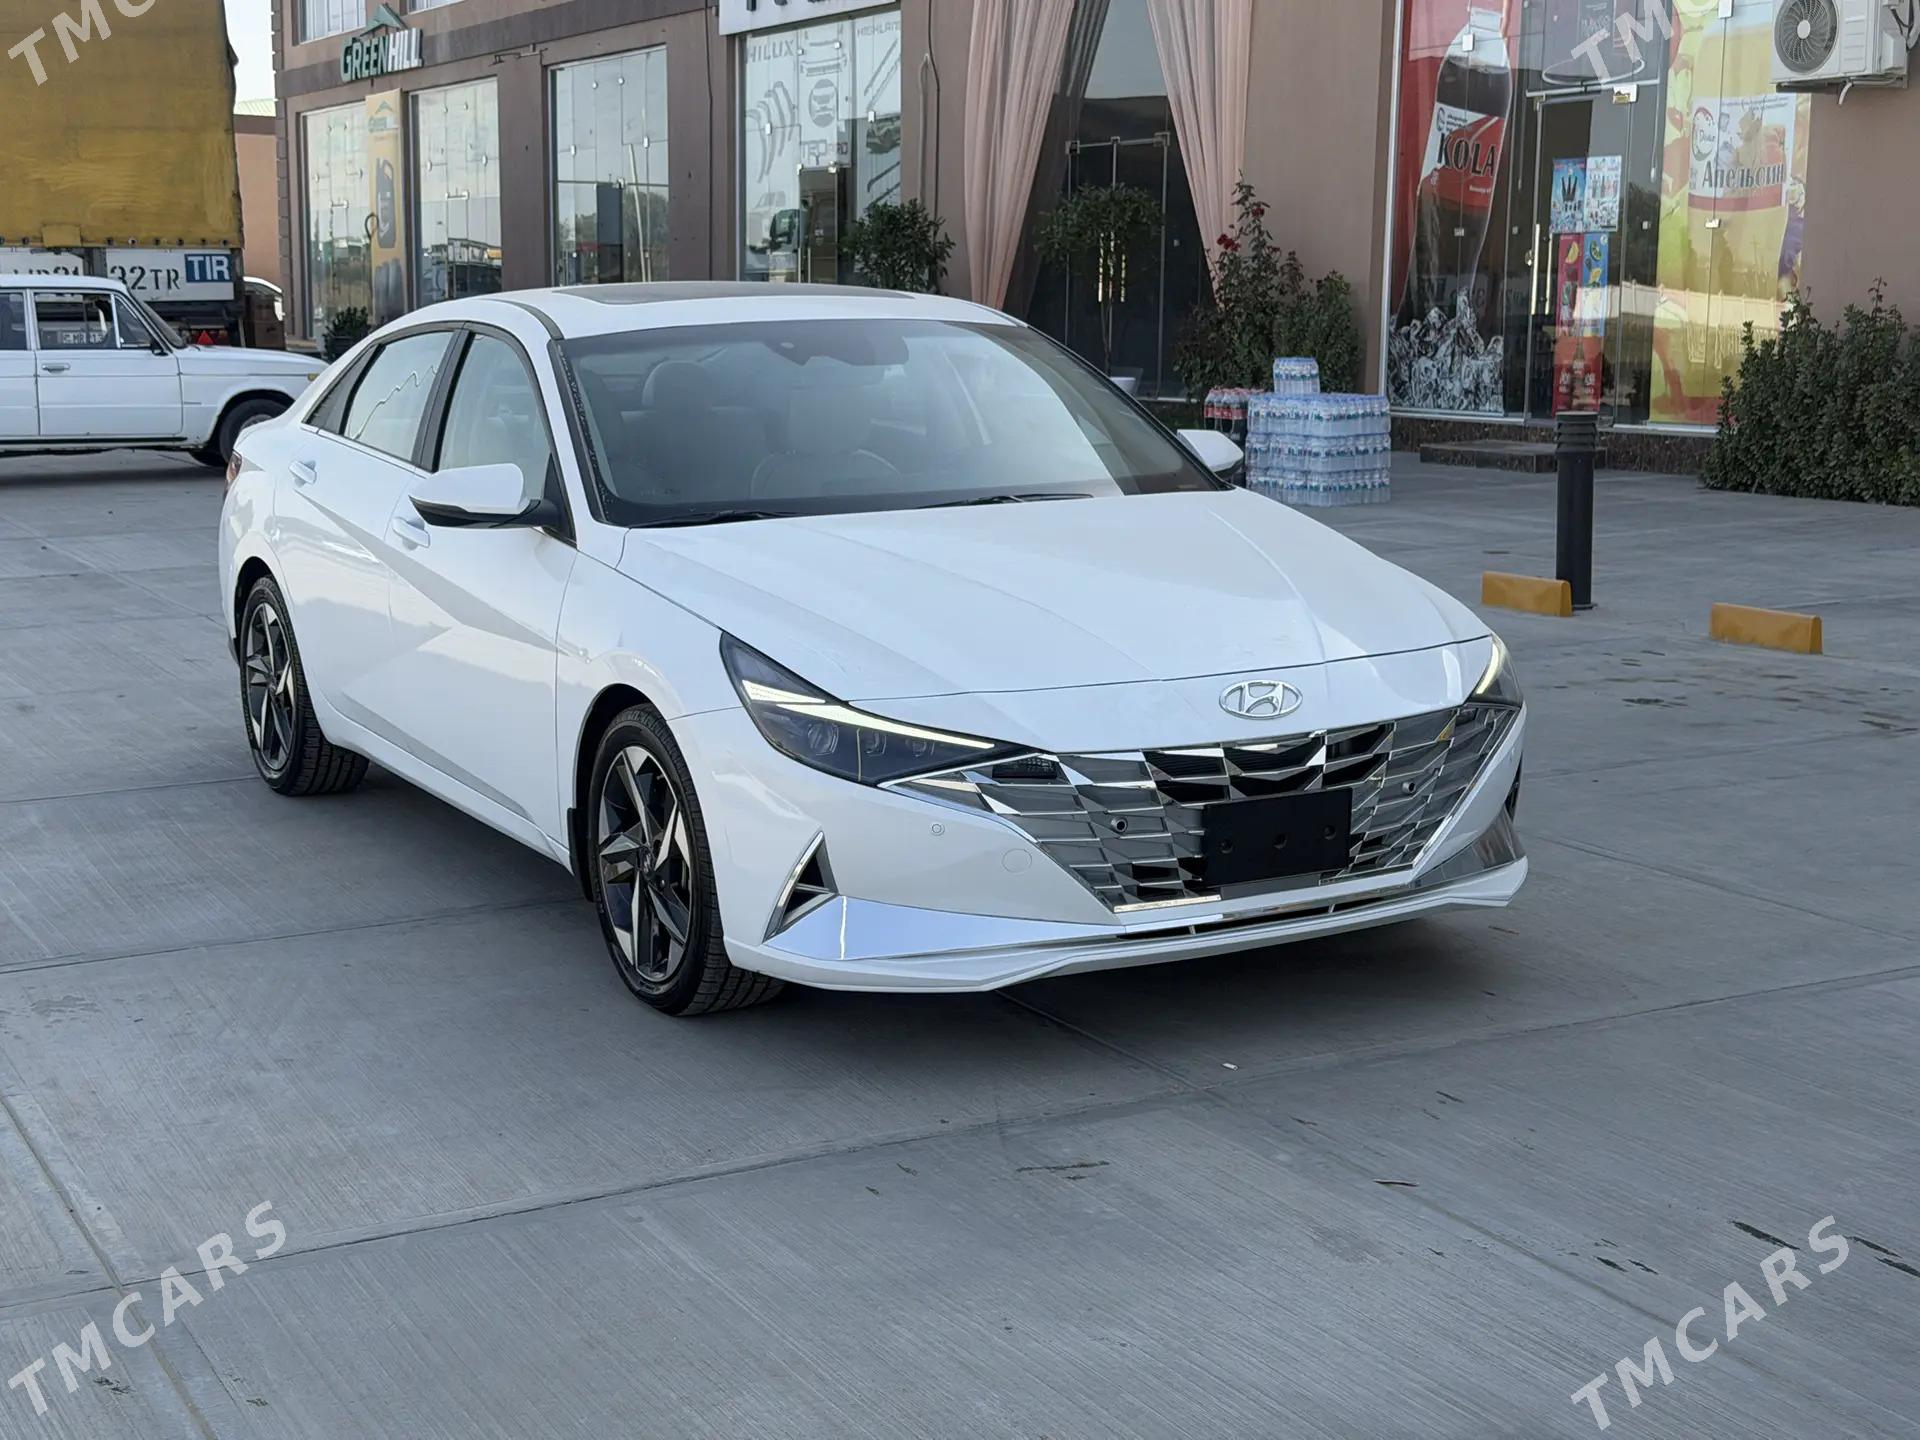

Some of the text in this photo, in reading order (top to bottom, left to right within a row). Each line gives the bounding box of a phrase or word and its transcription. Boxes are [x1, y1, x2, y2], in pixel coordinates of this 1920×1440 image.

[340, 27, 423, 83] GREENHILL
[745, 39, 795, 64] HILUX
[1437, 133, 1495, 177] KOLA
[1702, 160, 1784, 188] Апельсин
[187, 256, 230, 281] TIR
